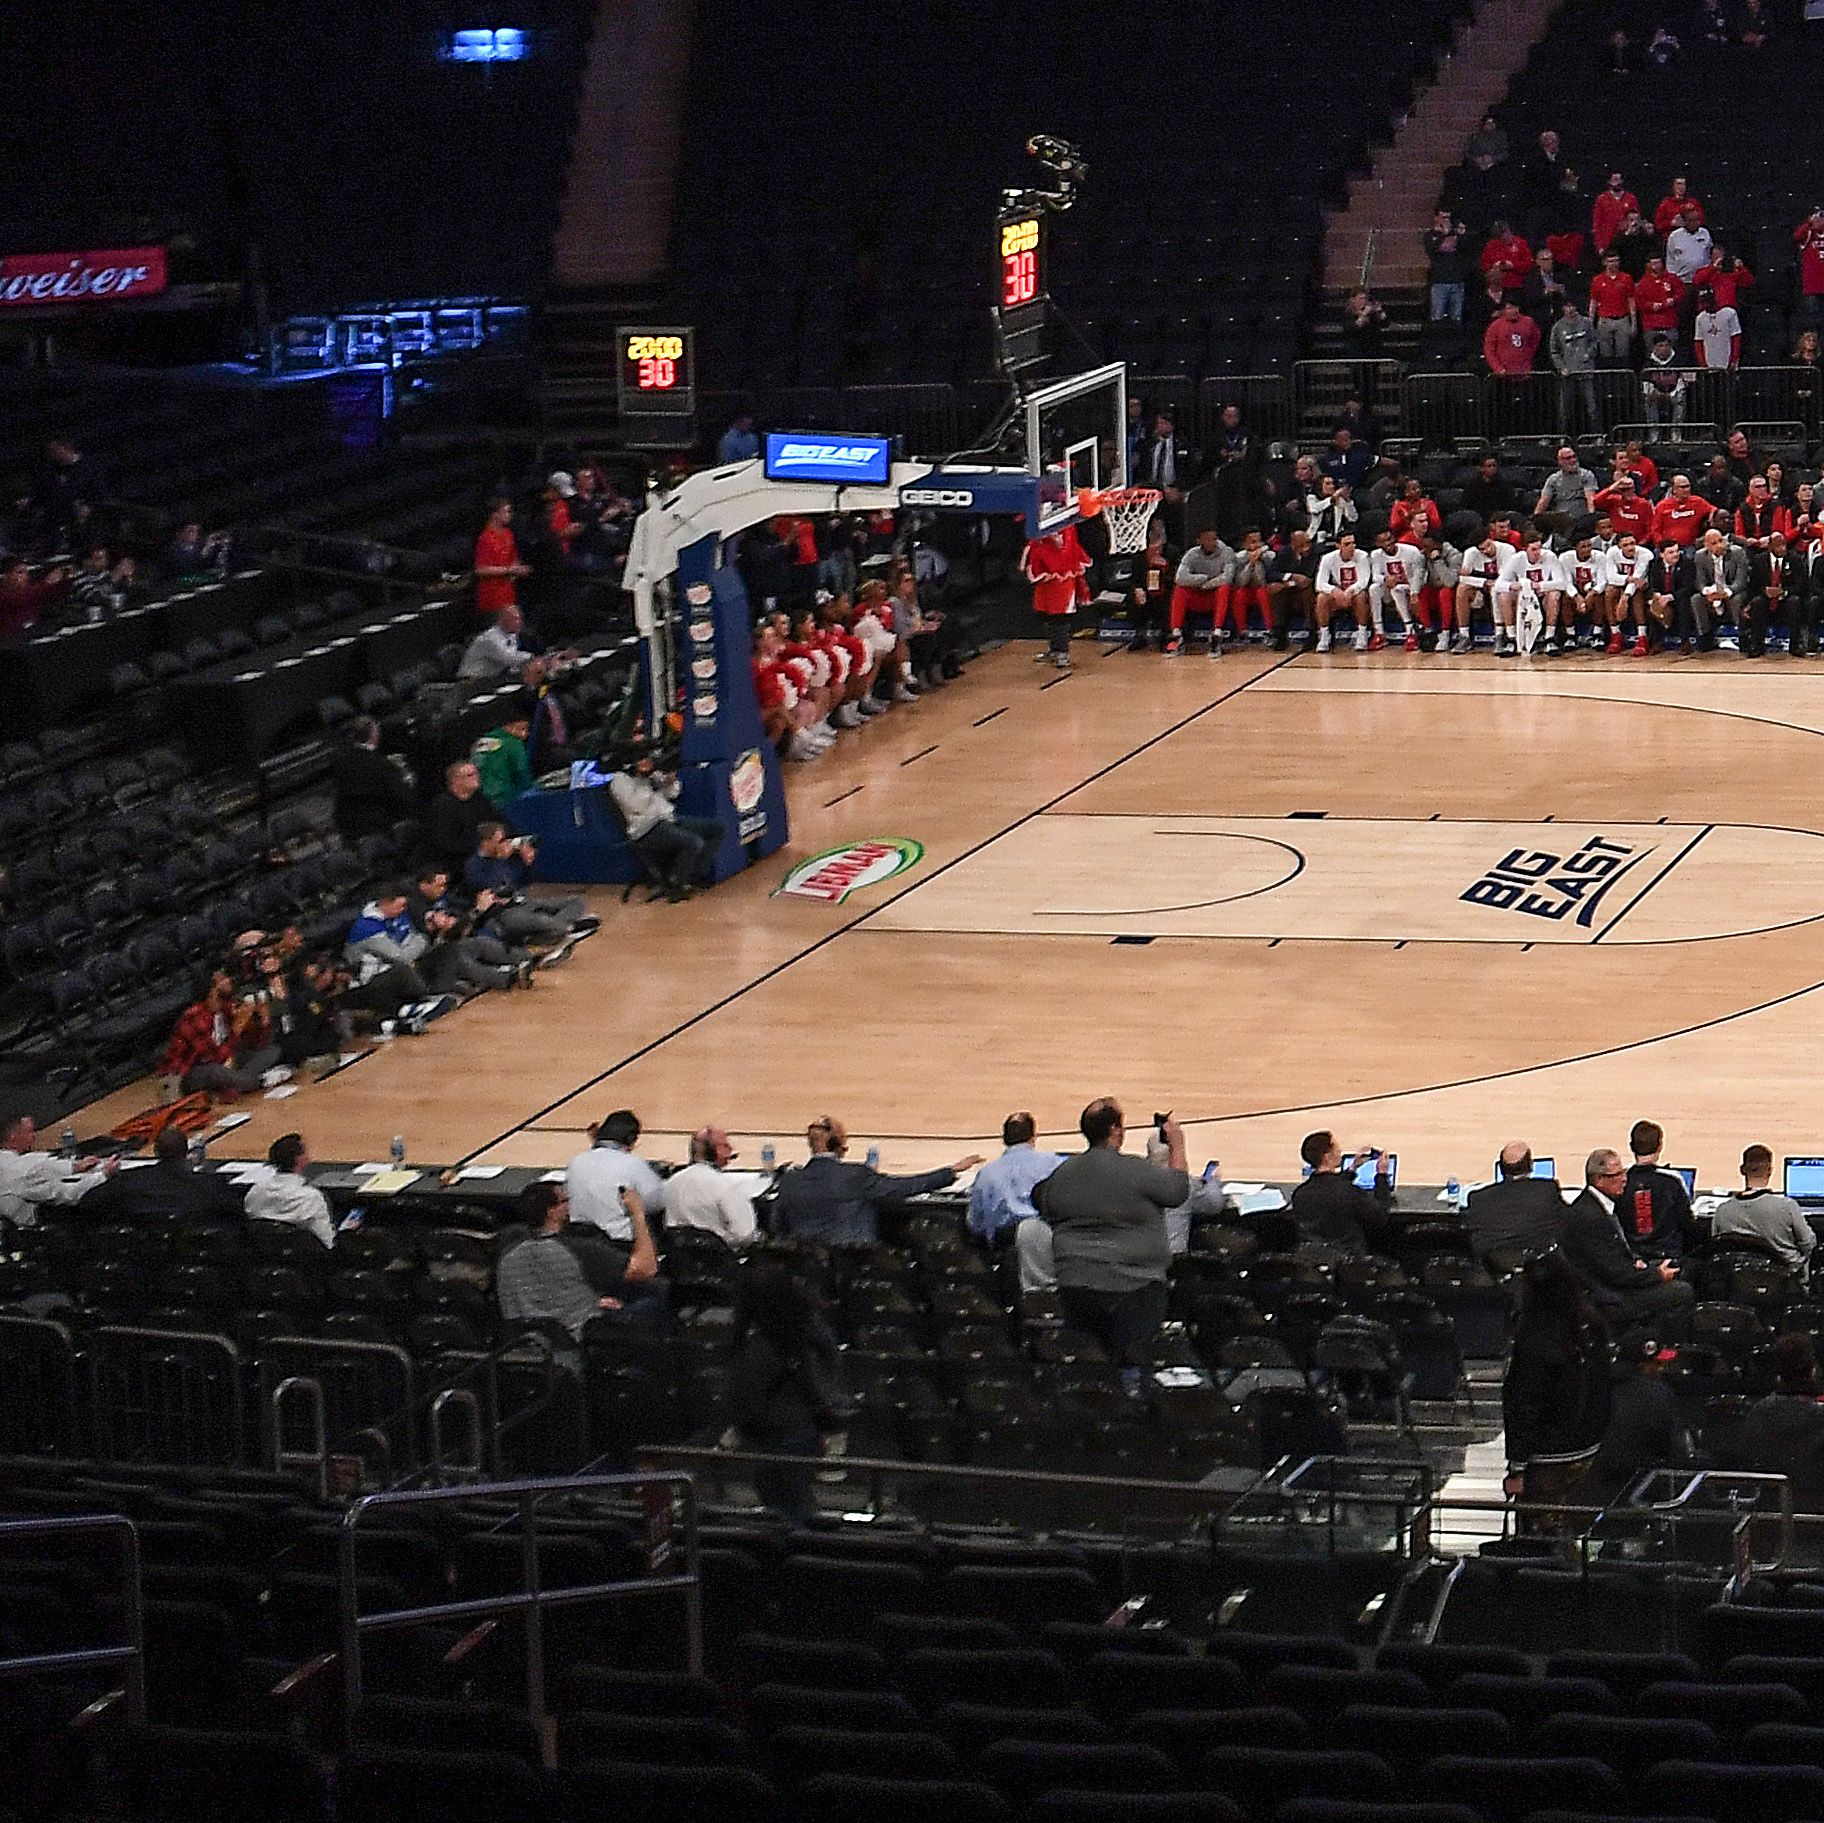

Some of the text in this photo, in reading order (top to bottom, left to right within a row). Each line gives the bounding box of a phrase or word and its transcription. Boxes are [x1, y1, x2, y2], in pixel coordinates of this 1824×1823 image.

[0, 259, 149, 301] weiser
[1004, 251, 1036, 305] 30
[638, 357, 675, 390] 30
[902, 488, 974, 507] GEICO
[1458, 846, 1562, 910] BIG
[1515, 835, 1637, 921] EAST
